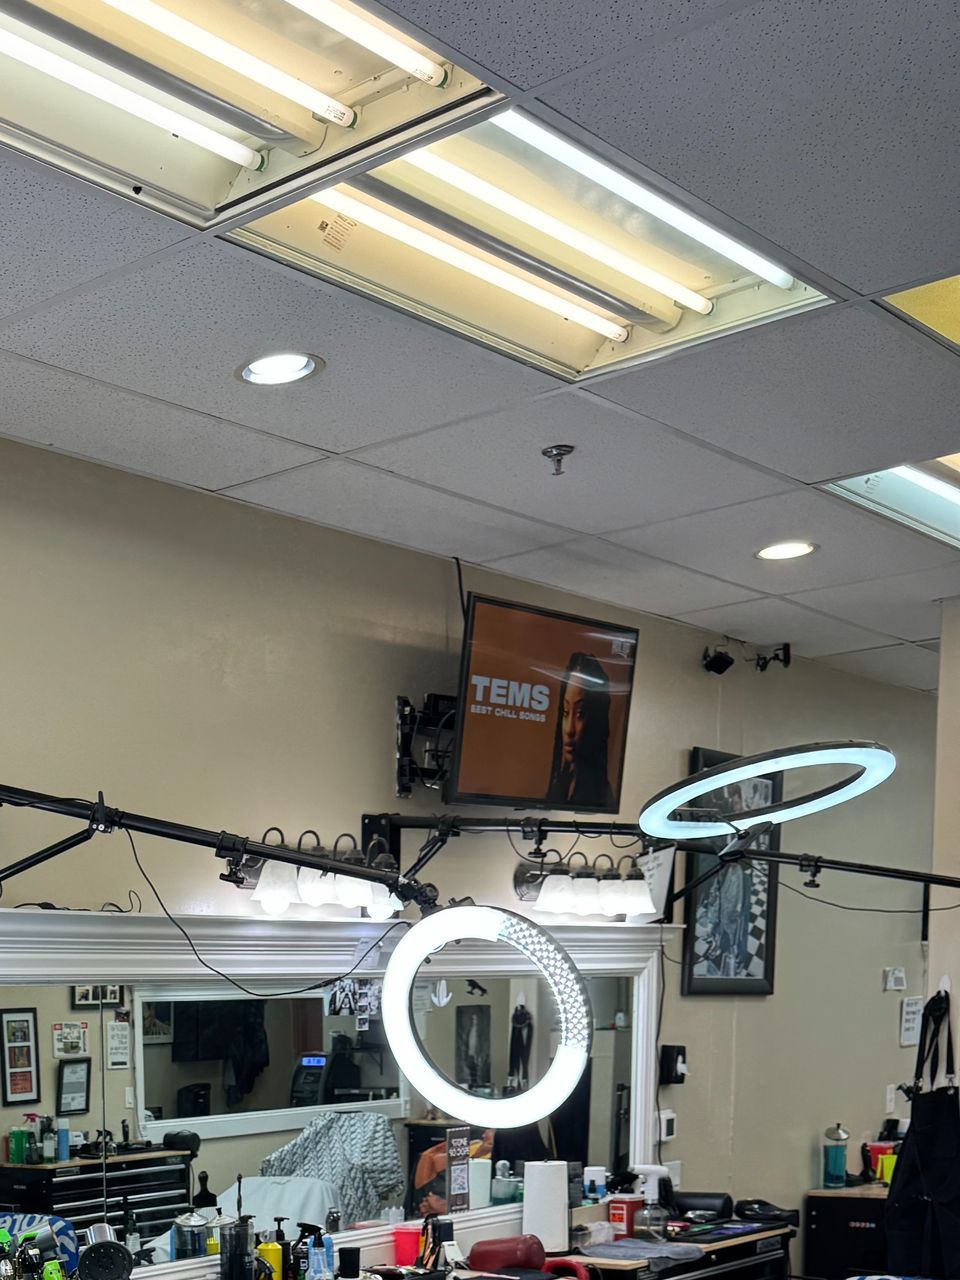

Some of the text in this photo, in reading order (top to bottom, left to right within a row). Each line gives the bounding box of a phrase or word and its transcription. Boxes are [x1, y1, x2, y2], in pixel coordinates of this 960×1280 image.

[471, 675, 550, 711] TEMS
[470, 704, 546, 722] BEST CHILL SONGS
